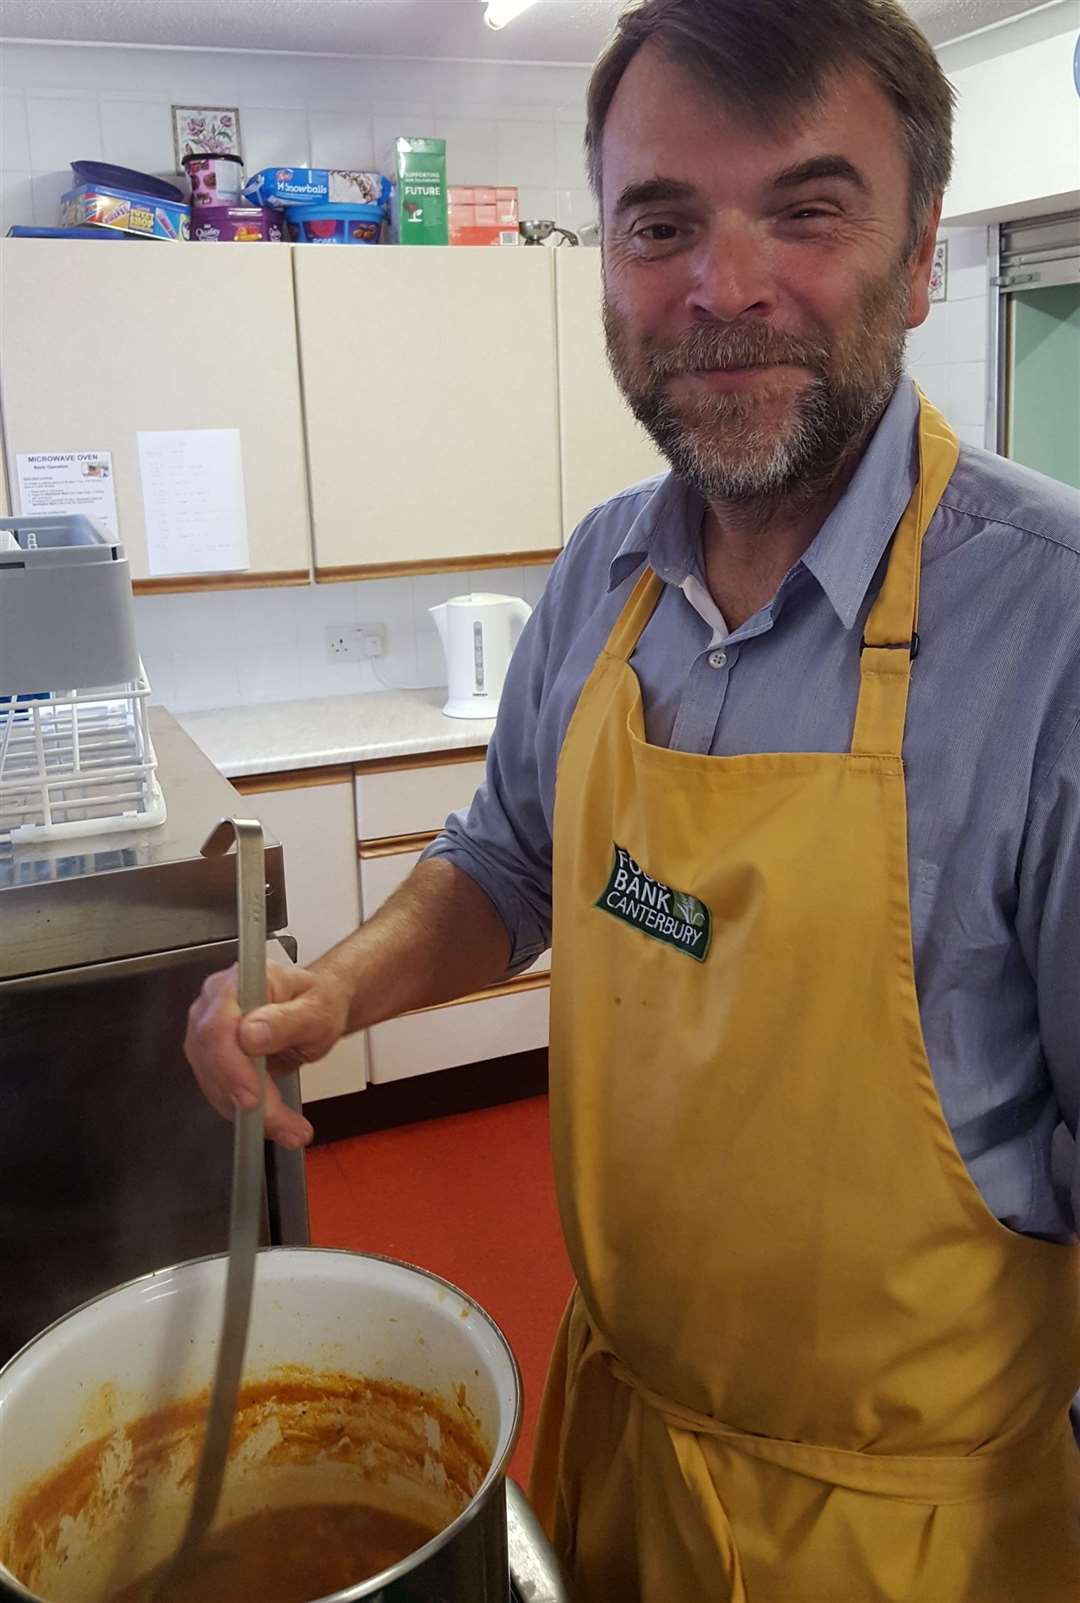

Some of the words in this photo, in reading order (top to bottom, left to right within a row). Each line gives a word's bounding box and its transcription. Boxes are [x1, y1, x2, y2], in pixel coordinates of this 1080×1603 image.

[285, 183, 327, 194] Snowballs
[405, 186, 440, 196] FUTURE
[28, 455, 75, 463] MICROWAVE
[614, 868, 671, 914] BANK
[607, 891, 702, 947] CANTERBURY
